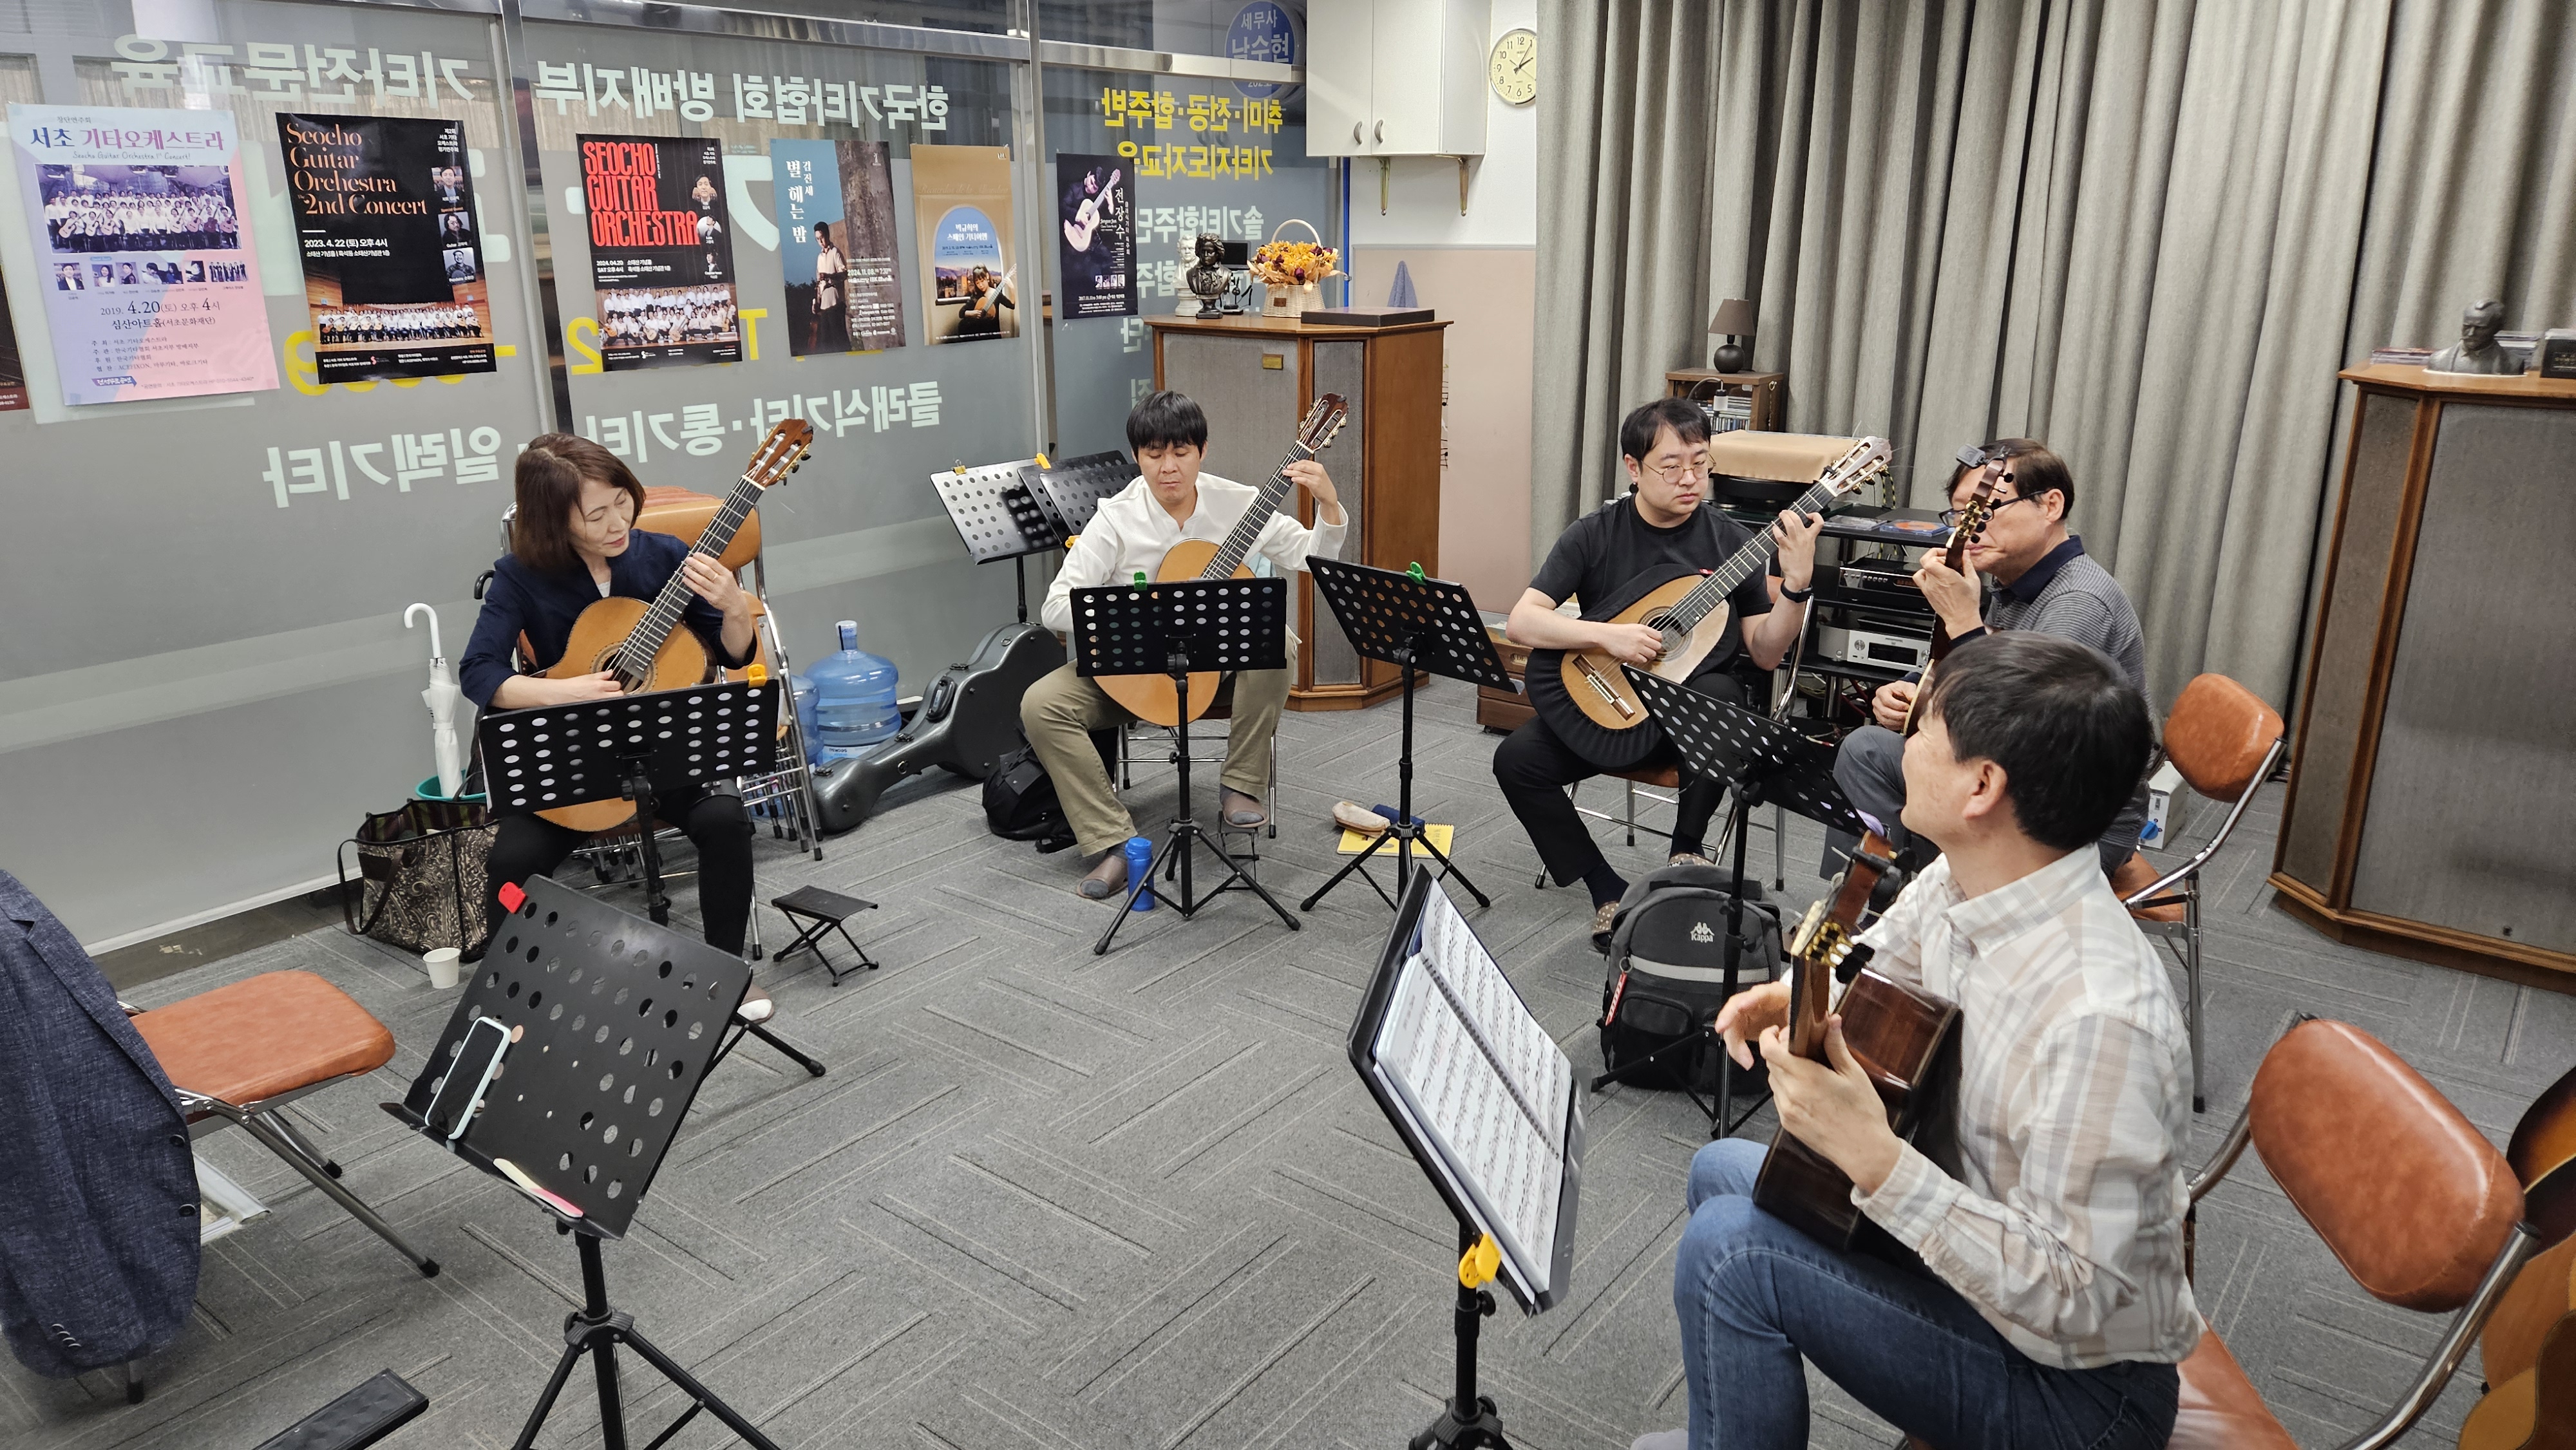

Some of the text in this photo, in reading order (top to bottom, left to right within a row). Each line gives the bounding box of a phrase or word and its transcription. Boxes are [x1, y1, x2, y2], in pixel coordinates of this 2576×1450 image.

[1241, 9, 1277, 30] 세무사
[1507, 41, 1513, 50] 11
[1517, 37, 1524, 45] 12
[1500, 51, 1507, 59] 10
[1497, 64, 1502, 72] 9
[1499, 76, 1504, 84] 8
[1507, 85, 1511, 93] 7
[1517, 88, 1522, 97] 6
[1527, 84, 1532, 93] 5
[30, 127, 224, 151] 서초 기타오케스트라
[287, 122, 363, 146] Seocho
[72, 151, 96, 159] Seocho
[97, 151, 120, 160] Guitar
[121, 151, 155, 160] Orchestra
[290, 146, 359, 169] Guitar
[583, 141, 656, 176] SEOCHO
[786, 160, 802, 178] 별
[294, 169, 397, 193] Orchestra
[587, 174, 659, 212] GUITAR
[303, 193, 345, 214] 2nd
[348, 193, 428, 214] Concert
[591, 210, 701, 247] ORCHESTRA
[792, 225, 808, 243] 밤
[100, 307, 124, 315] 2019.
[181, 301, 199, 312] 오후
[1691, 933, 1714, 943] Kappa
